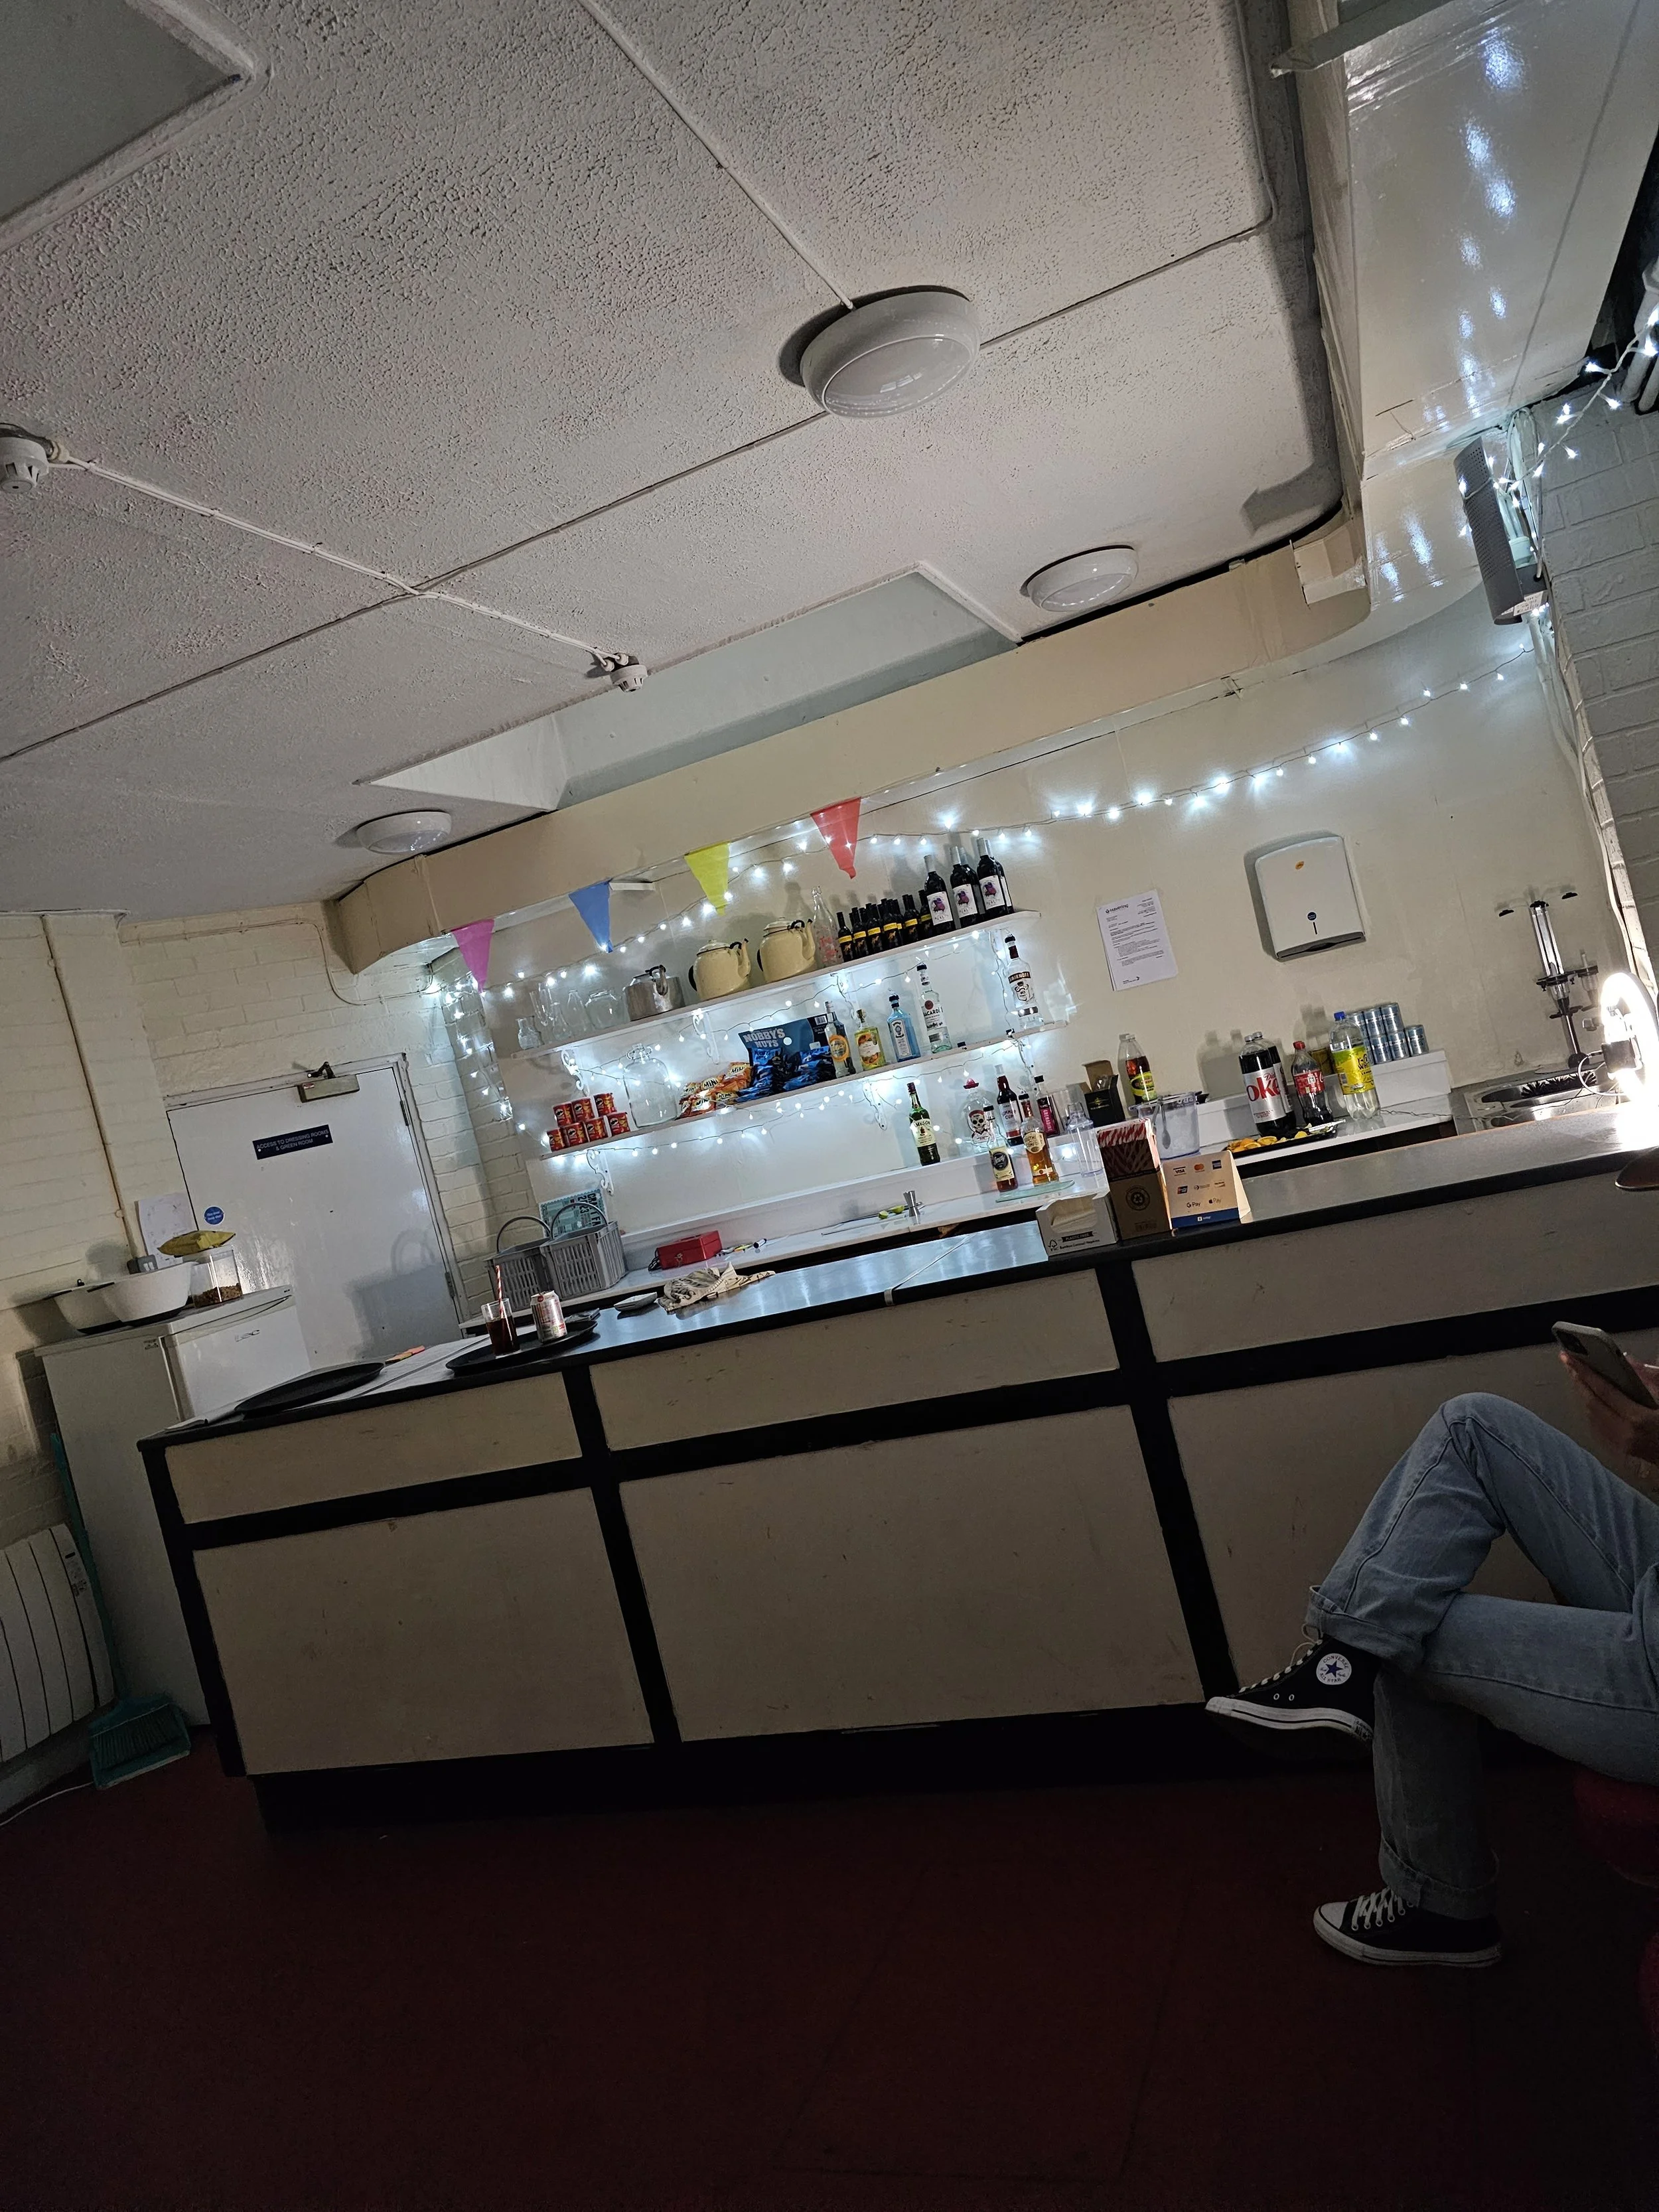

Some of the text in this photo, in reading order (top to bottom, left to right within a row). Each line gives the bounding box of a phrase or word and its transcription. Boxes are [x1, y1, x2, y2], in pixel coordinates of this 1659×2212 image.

[743, 1028, 785, 1043] NOBBY'S
[754, 1039, 779, 1048] NUTS
[1246, 1077, 1281, 1102] oke
[257, 1141, 277, 1149] ACCESS
[285, 1134, 310, 1143] DRESSING
[587, 1193, 599, 1215] CRAT
[1323, 1655, 1349, 1669] CONVERSE
